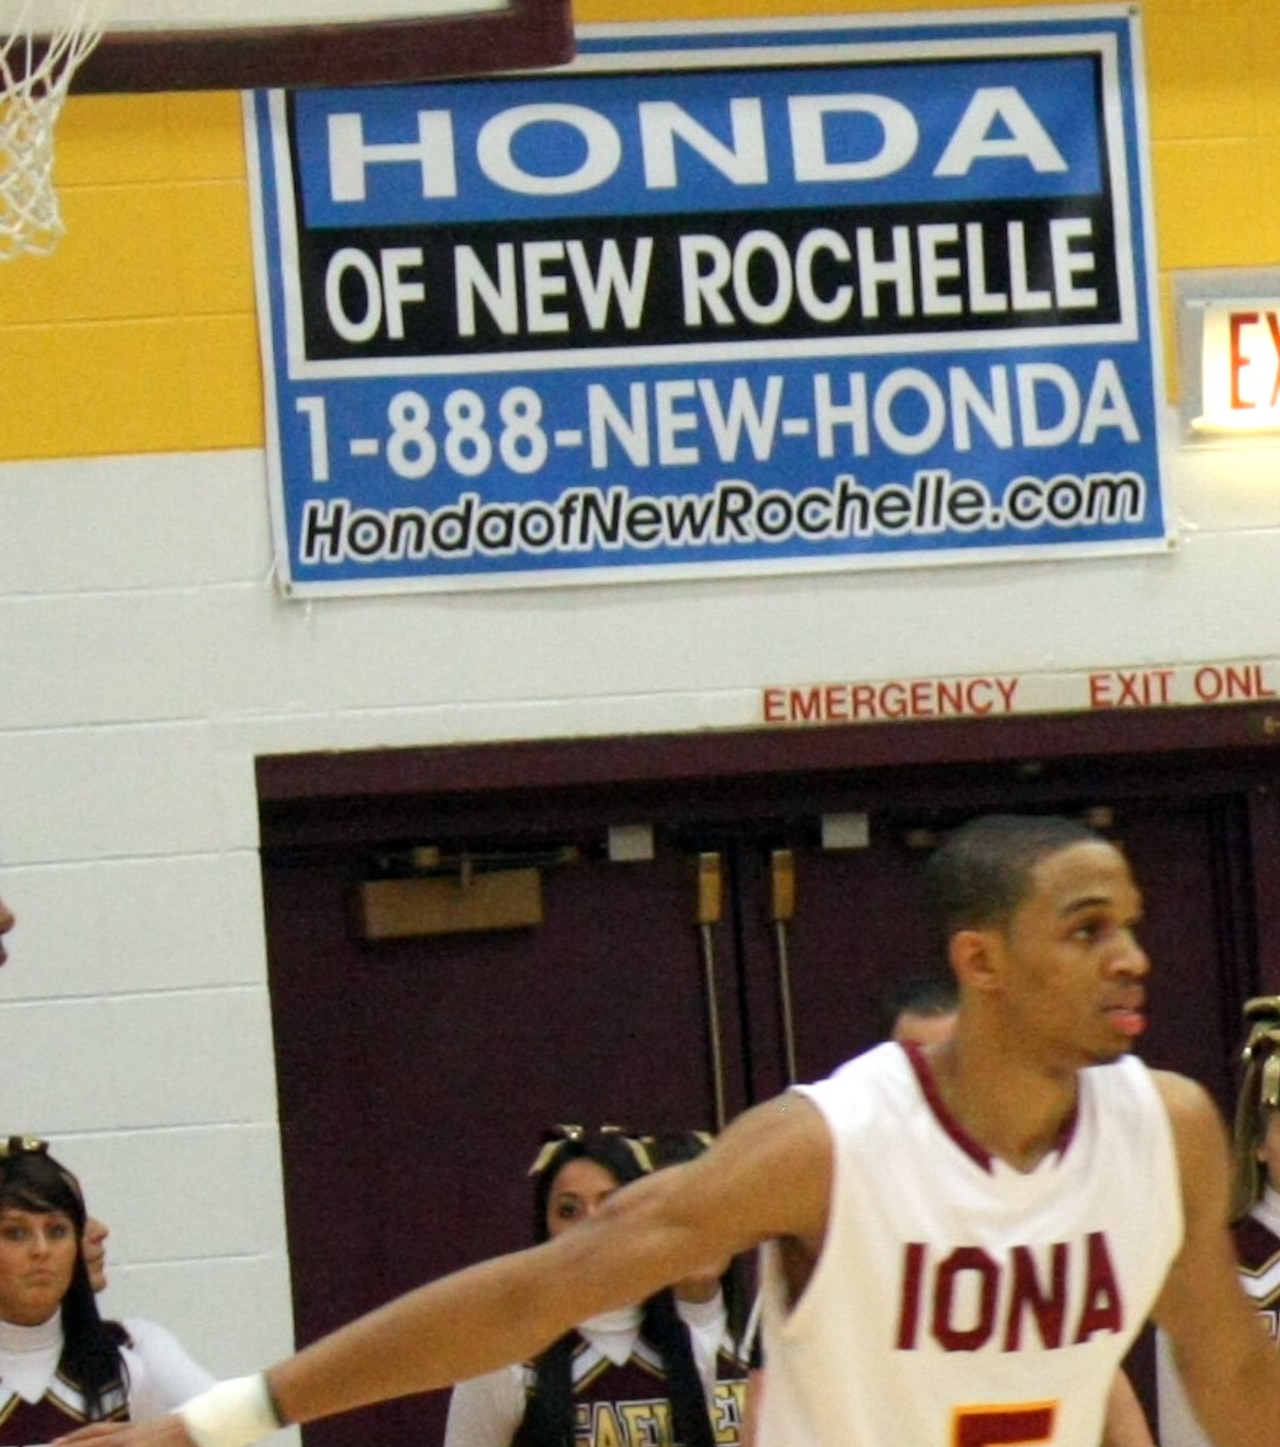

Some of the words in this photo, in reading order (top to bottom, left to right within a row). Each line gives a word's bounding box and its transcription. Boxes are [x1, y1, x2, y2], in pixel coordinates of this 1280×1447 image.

[327, 86, 1068, 202] HONDA
[325, 247, 425, 343] OF
[454, 237, 654, 336] NEW
[680, 217, 1098, 327] ROCHELLE
[296, 358, 1140, 482] 1-888-NEW-HONDA
[303, 472, 1141, 562] HondaofNewRochelle.com
[763, 678, 1018, 722] EMERGENCY
[1089, 671, 1173, 708] EXIT
[1194, 664, 1276, 702] ONL
[895, 1230, 1125, 1353] IONA
